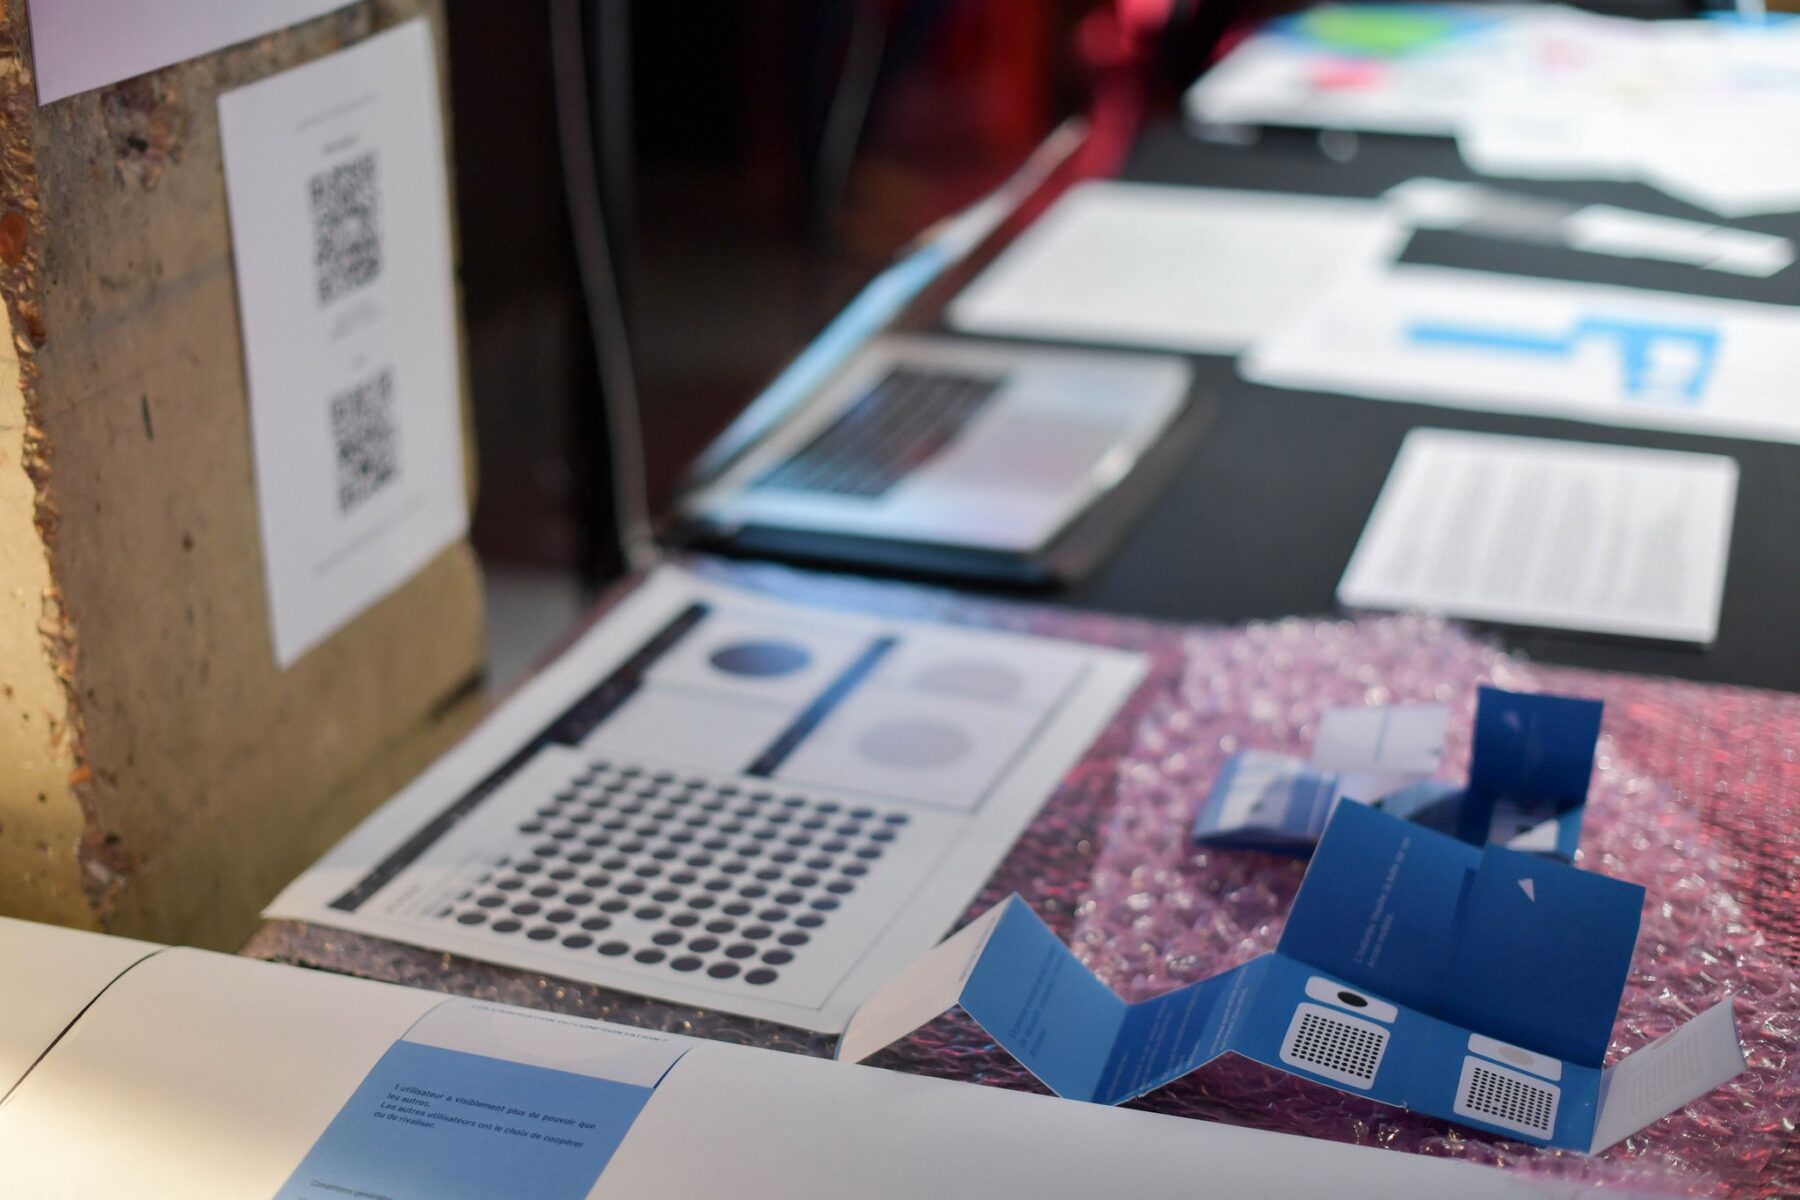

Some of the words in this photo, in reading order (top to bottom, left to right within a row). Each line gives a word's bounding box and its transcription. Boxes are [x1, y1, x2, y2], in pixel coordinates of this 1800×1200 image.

[386, 1093, 401, 1101] les
[401, 1096, 431, 1108] autres.
[400, 1086, 445, 1099] utilisateur
[455, 1097, 506, 1112] visiblement
[505, 1107, 526, 1116] plus
[528, 1111, 540, 1119] de
[541, 1114, 576, 1126] pouvoir
[579, 1120, 596, 1129] que
[380, 1101, 398, 1110] Les
[397, 1106, 426, 1116] autres
[427, 1112, 477, 1127] utilisateurs
[477, 1122, 493, 1130] ont
[493, 1124, 503, 1132] le
[504, 1127, 529, 1137] choix
[543, 1135, 585, 1148] coopérer
[386, 1113, 398, 1121] de
[398, 1116, 436, 1128] rivaliser.
